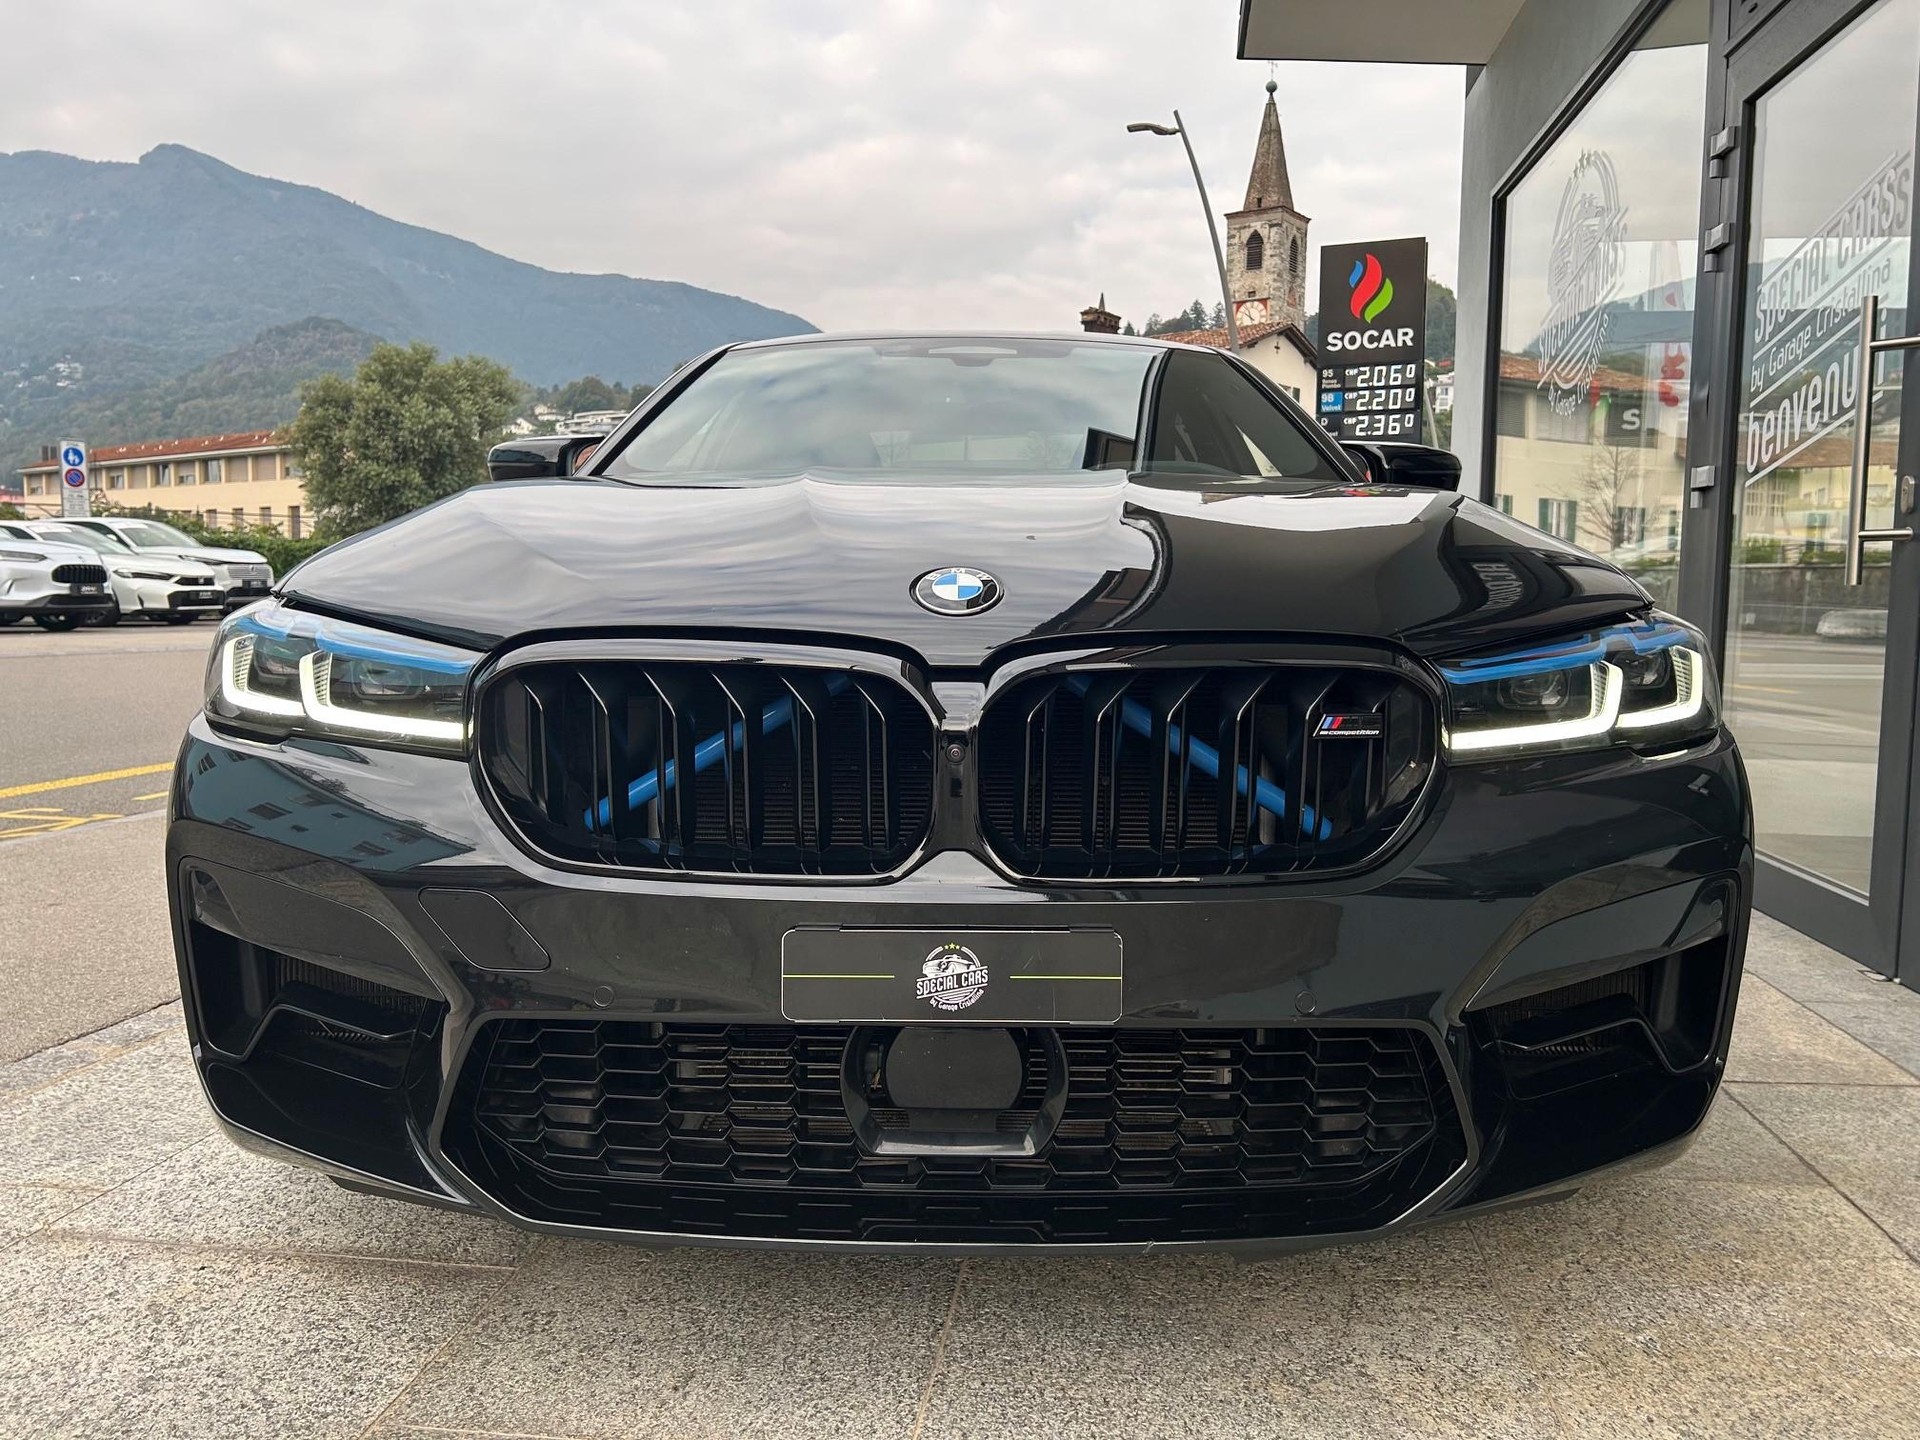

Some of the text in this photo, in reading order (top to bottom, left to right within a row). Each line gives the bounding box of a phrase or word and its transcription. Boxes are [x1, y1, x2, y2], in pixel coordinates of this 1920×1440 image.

[1755, 168, 1897, 344] SPECIAL CARS
[1750, 258, 1891, 393] by Garage Cristallina
[1326, 328, 1414, 352] SOCAR
[1322, 369, 1333, 378] 95
[1345, 368, 1358, 376] CHF
[1321, 393, 1334, 403] 98
[1344, 392, 1357, 400] CHF
[1746, 308, 1888, 474] benvenui
[1343, 417, 1357, 425] CHF
[916, 969, 989, 996] SPECIAL CARS
[929, 988, 985, 1012] by Garage Cristallina
